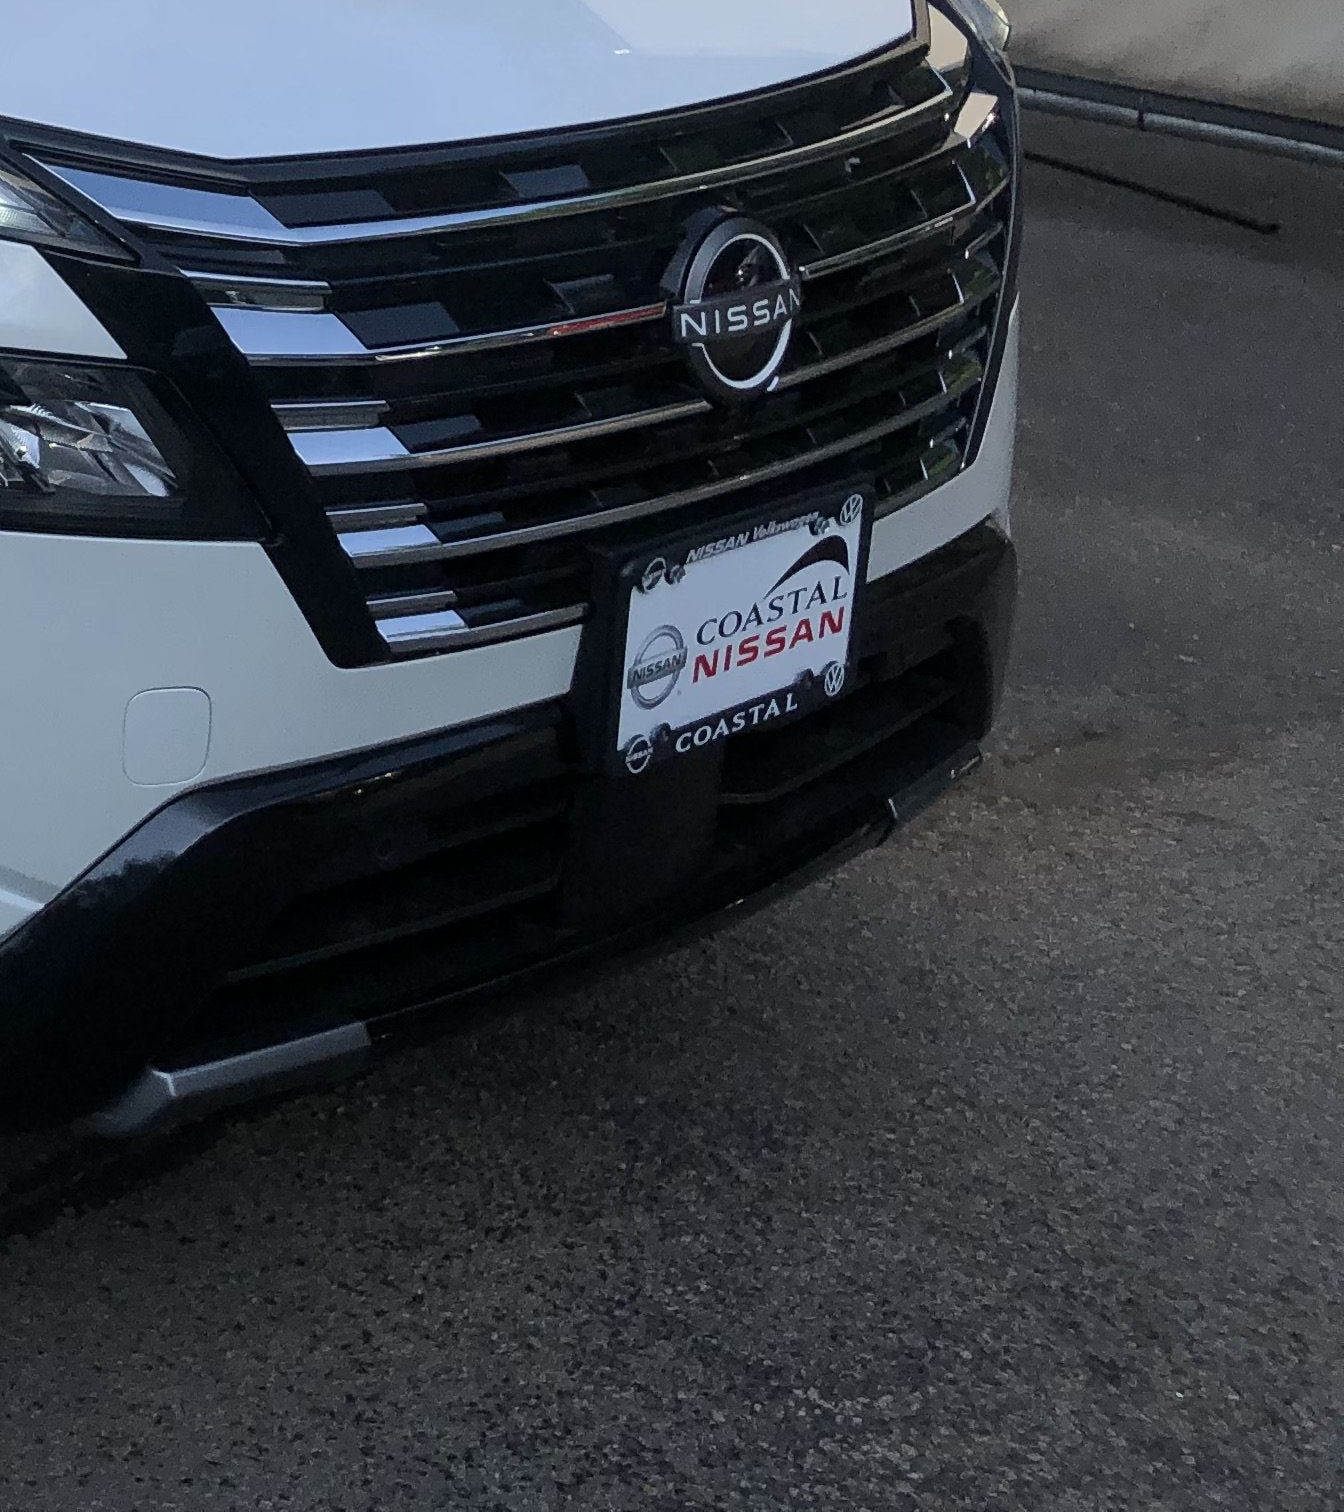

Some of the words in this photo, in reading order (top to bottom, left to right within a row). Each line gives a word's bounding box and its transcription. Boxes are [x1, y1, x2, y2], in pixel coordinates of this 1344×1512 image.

[680, 288, 800, 337] NISSAN
[686, 531, 750, 564] NISSAN
[697, 576, 847, 645] COASTAL
[632, 653, 682, 680] NISSAN
[692, 606, 844, 683] NISSAN
[675, 693, 798, 753] COASTAL
